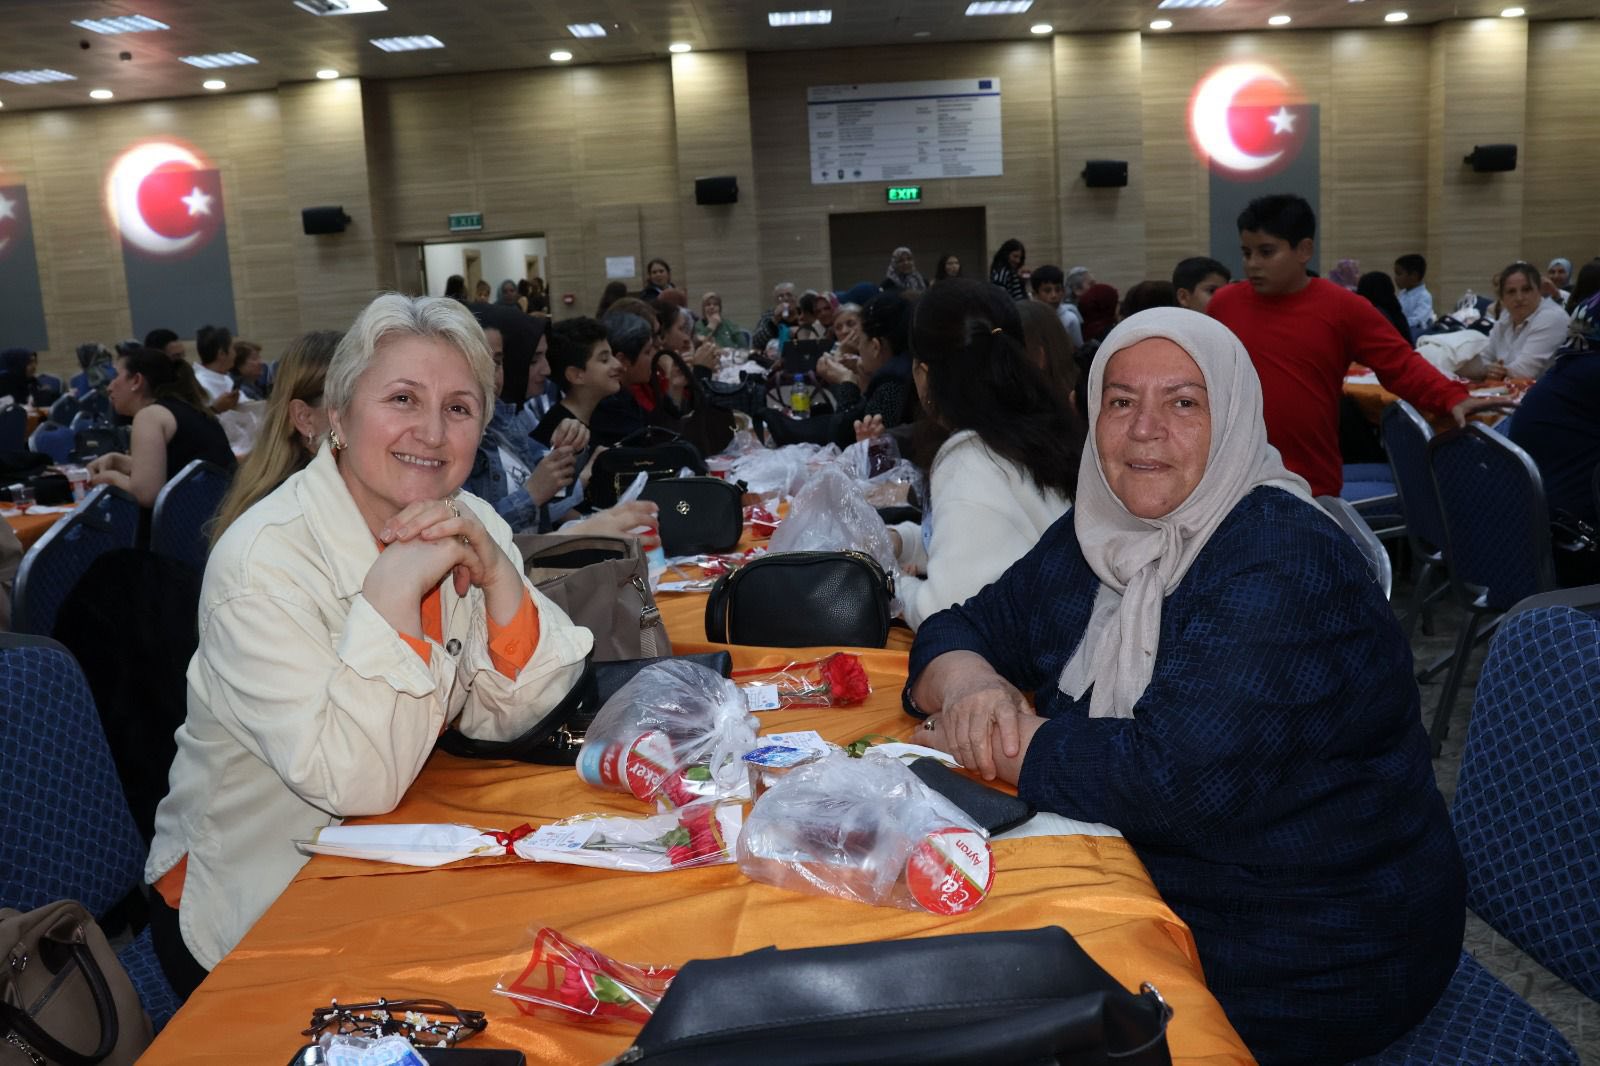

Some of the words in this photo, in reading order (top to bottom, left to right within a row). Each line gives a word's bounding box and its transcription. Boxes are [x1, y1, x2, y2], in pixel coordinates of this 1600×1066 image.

[889, 187, 918, 200] EXIT
[451, 216, 479, 227] EXIT
[956, 840, 982, 866] Ayran
